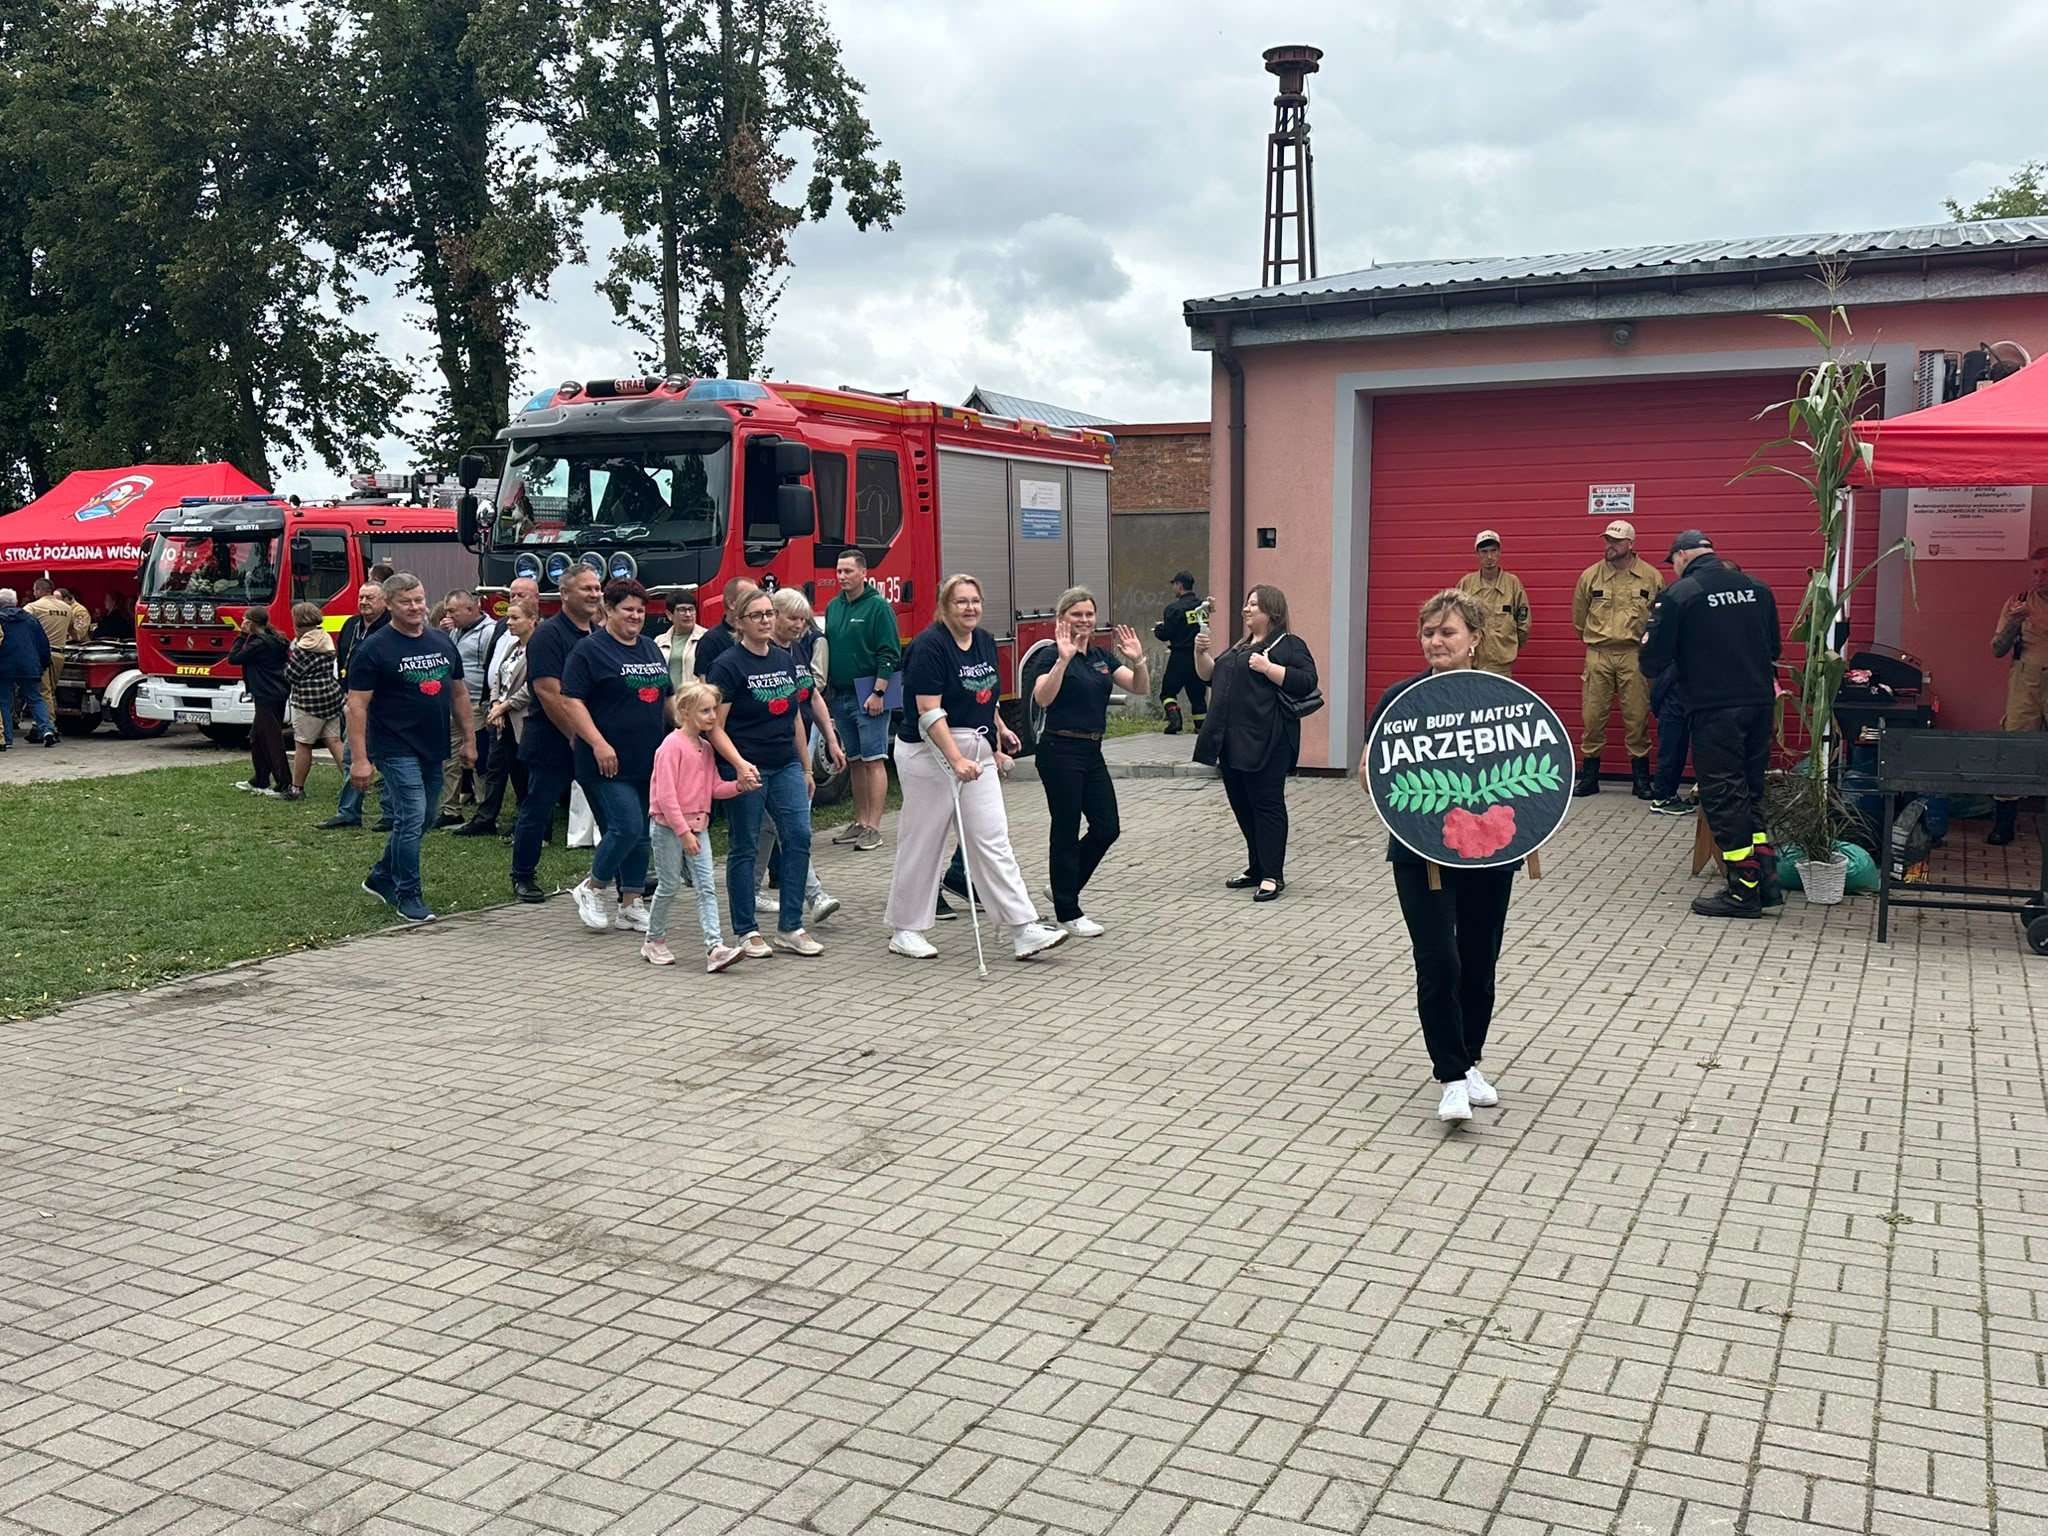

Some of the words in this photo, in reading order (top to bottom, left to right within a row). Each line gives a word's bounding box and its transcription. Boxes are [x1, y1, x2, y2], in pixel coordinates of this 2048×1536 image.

[5, 543, 42, 561] STRAŻ
[43, 542, 104, 560] POŻARNA
[398, 656, 450, 673] JARZĘBINA
[620, 666, 669, 676] JARZĘBIN
[747, 676, 795, 689] JARZĘBINA
[1383, 718, 1418, 736] KGW
[1426, 712, 1465, 730] BUDY
[1470, 702, 1536, 725] MATUSY
[1379, 718, 1559, 775] JARZĘBINA
